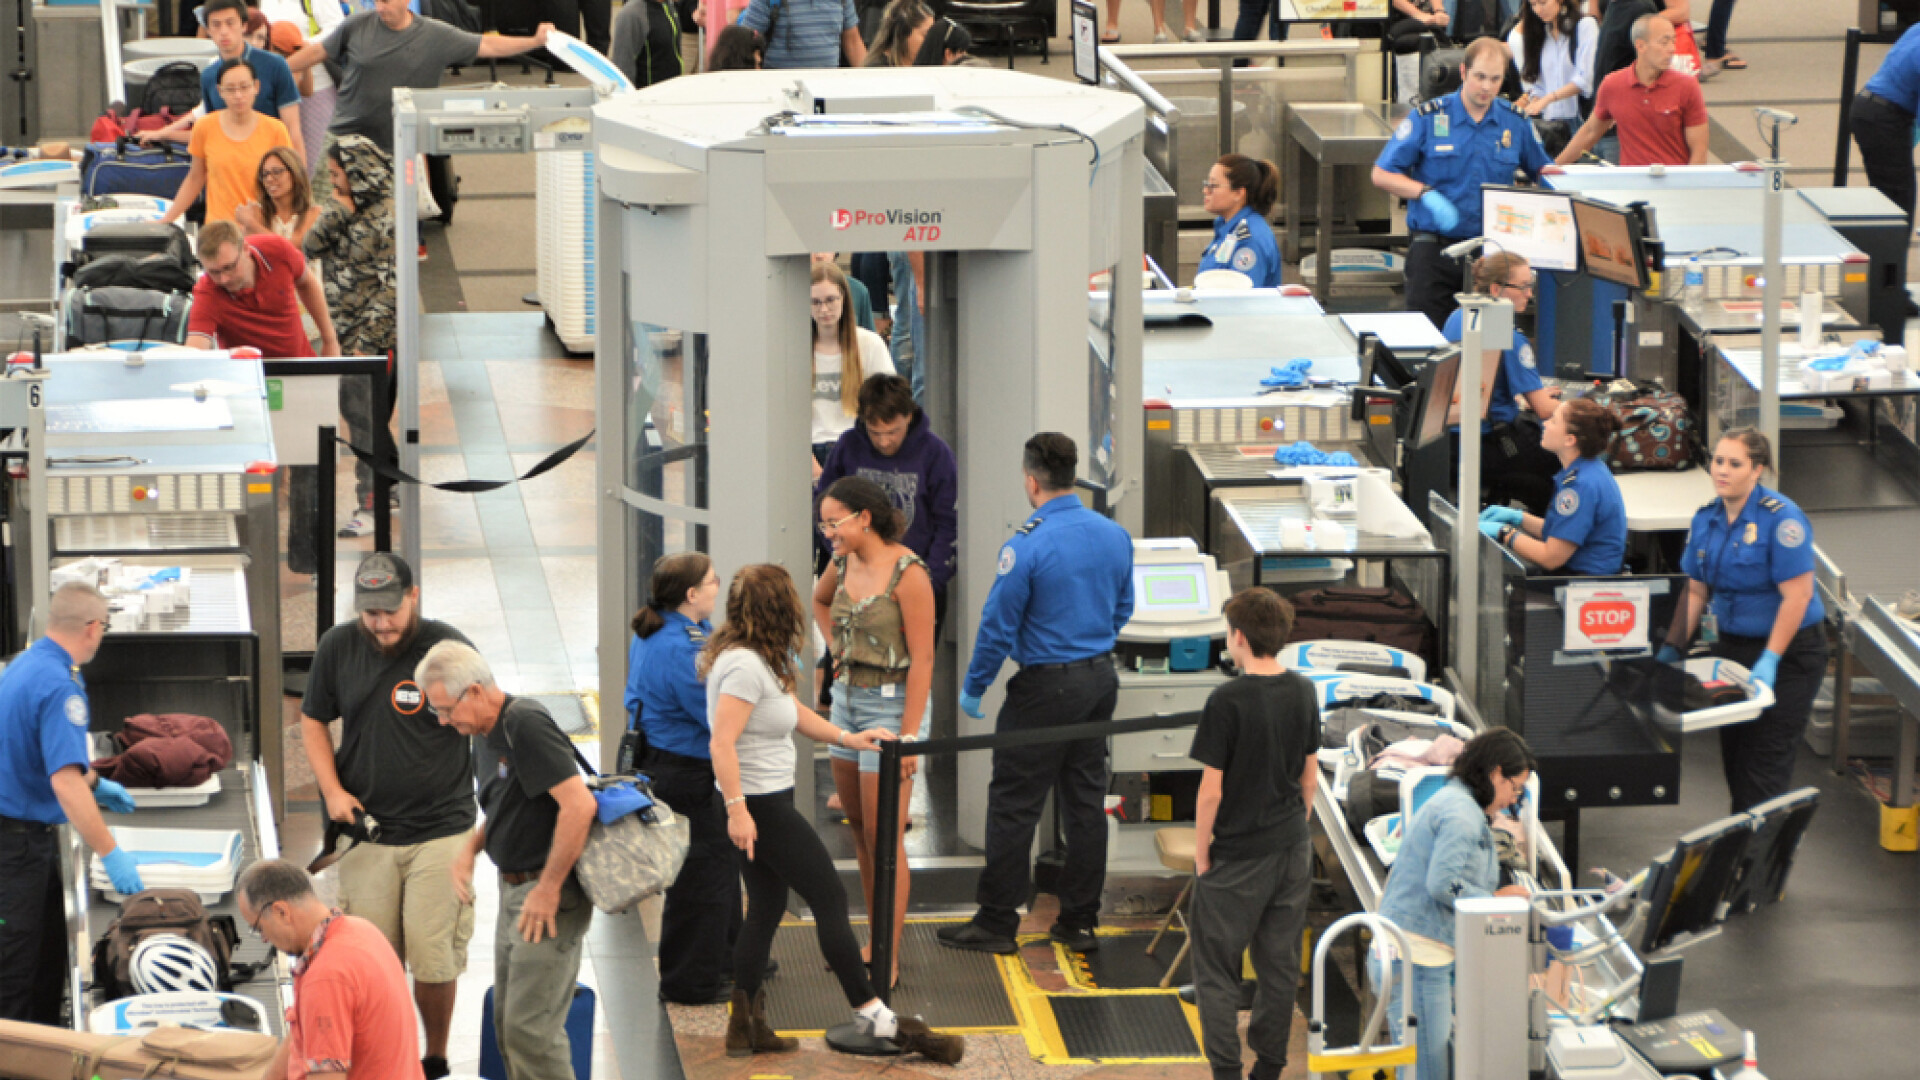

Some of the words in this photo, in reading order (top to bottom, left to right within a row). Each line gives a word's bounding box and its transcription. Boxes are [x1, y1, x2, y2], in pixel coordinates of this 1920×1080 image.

[1773, 170, 1782, 191] 8
[855, 208, 942, 225] ProVision
[902, 225, 942, 242] ATD
[1469, 308, 1479, 330] 7
[31, 384, 41, 407] 6
[1585, 610, 1631, 626] STOP
[1484, 923, 1522, 936] iLane
